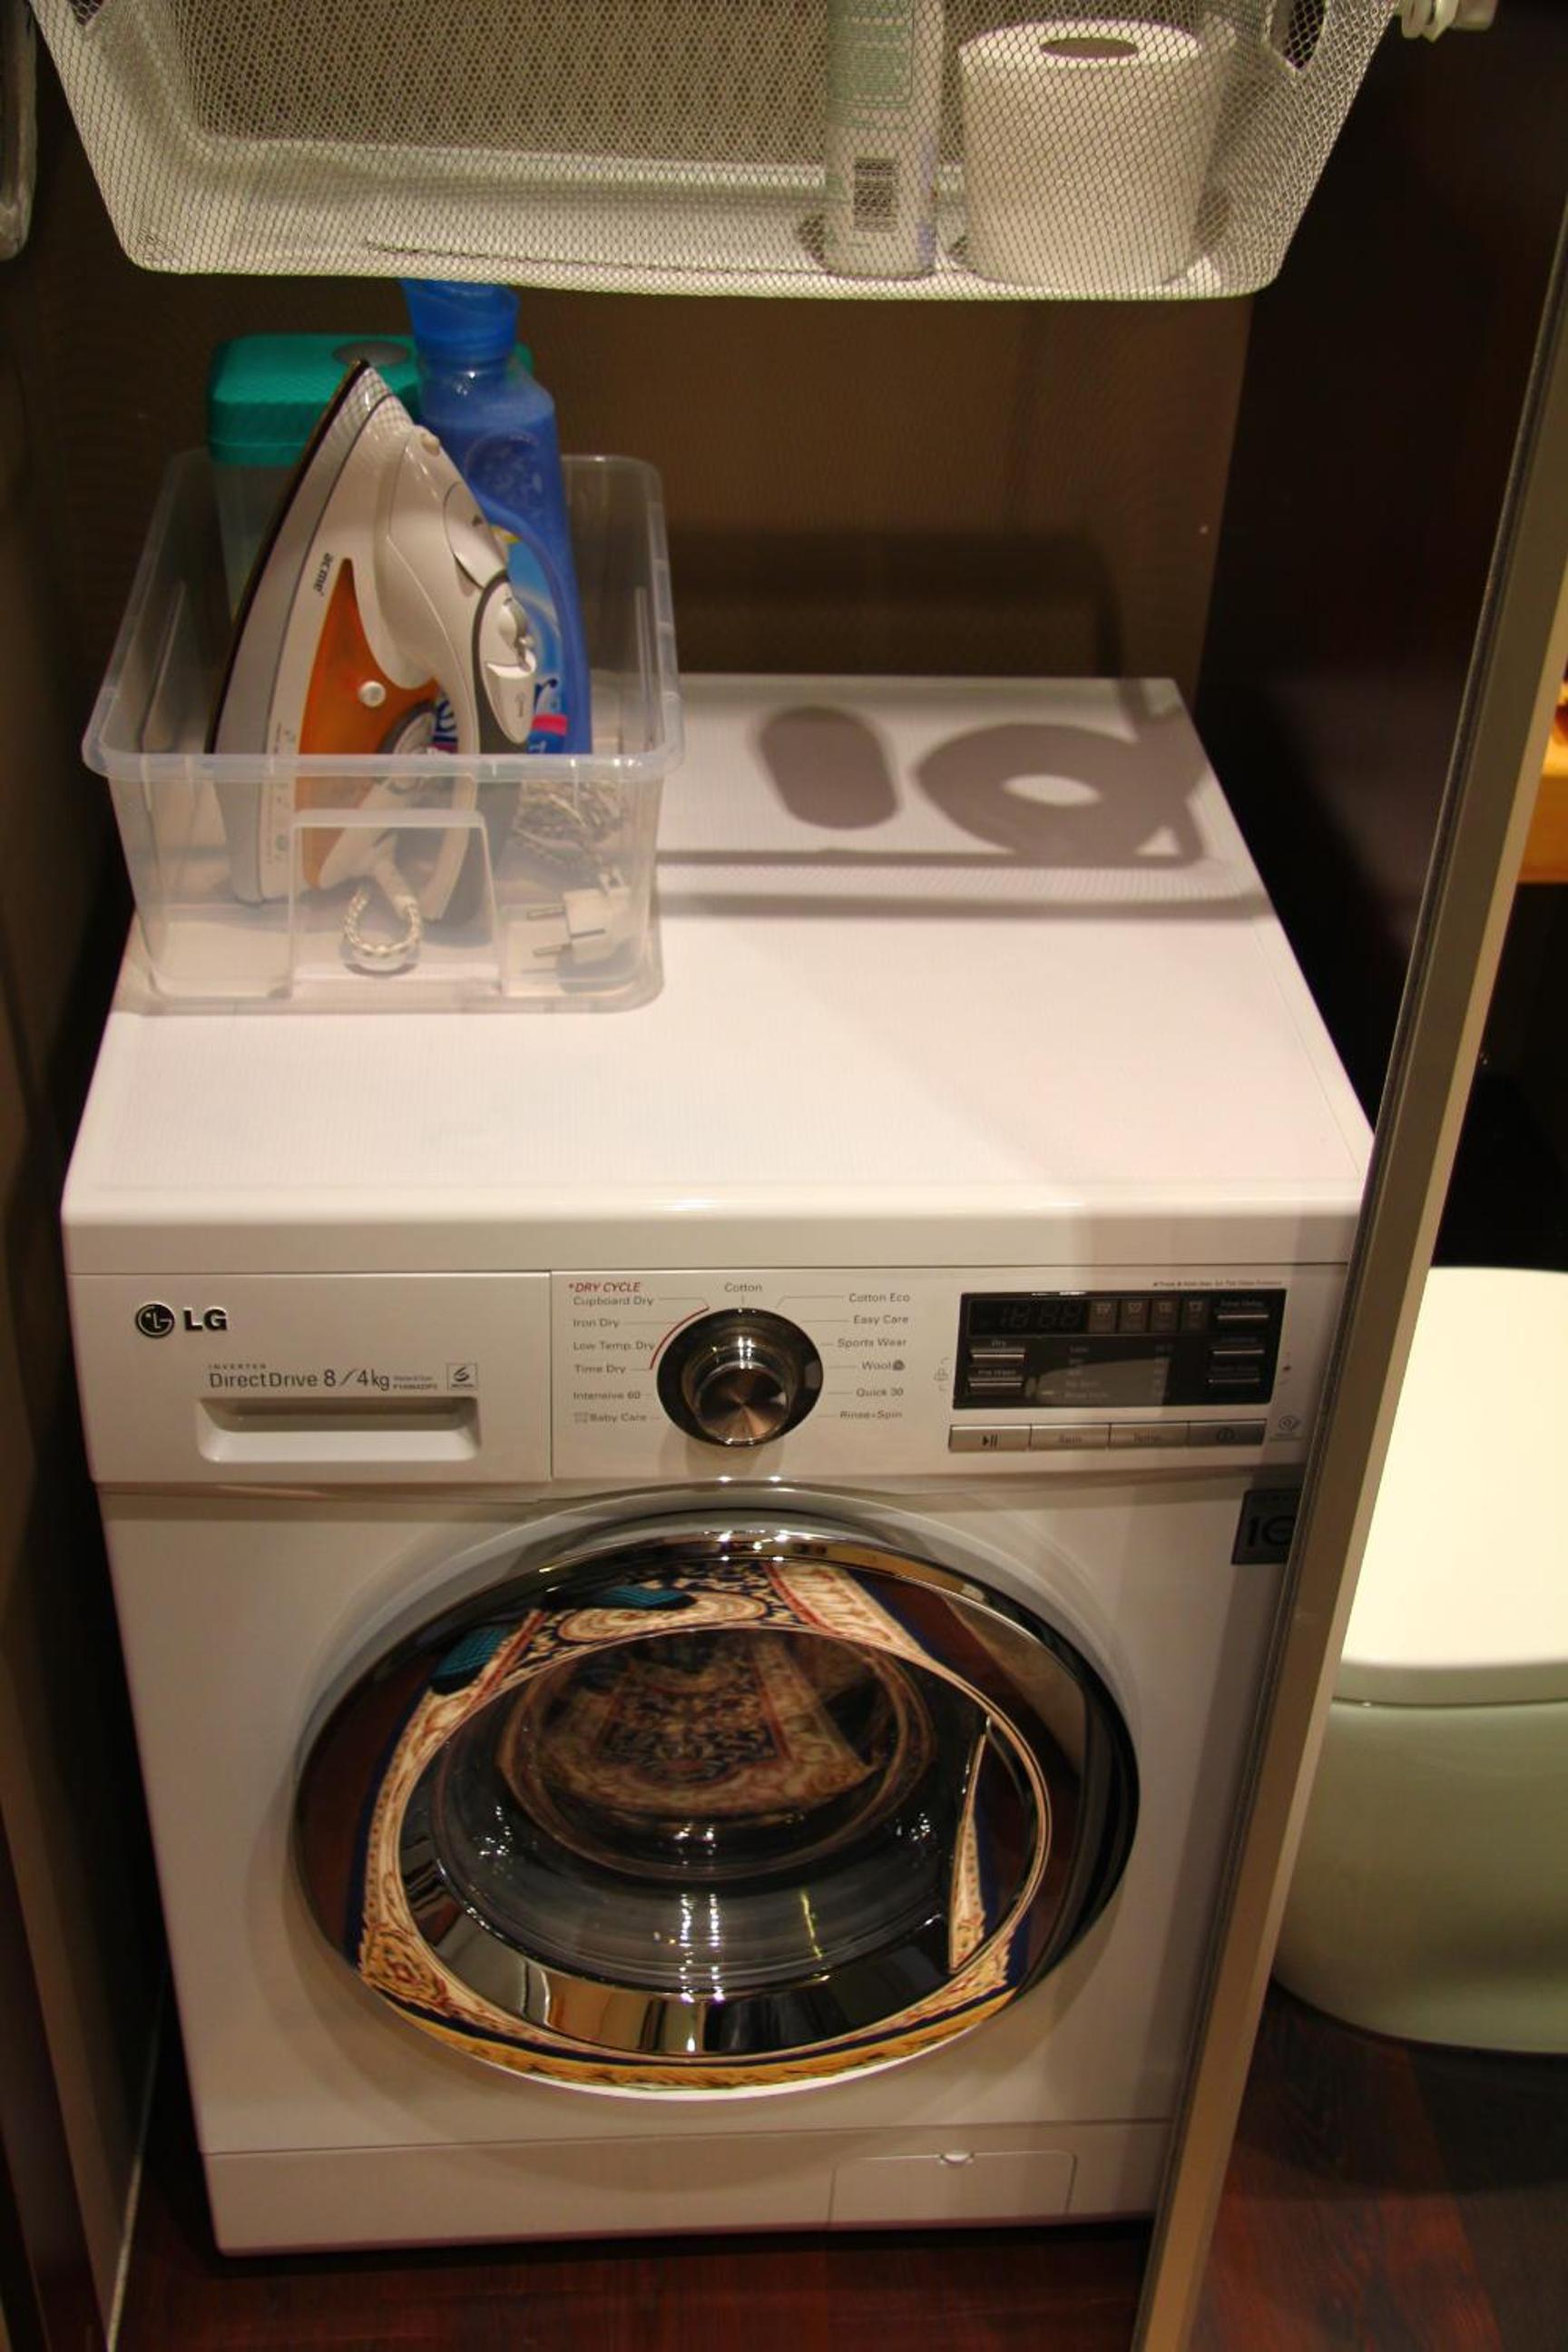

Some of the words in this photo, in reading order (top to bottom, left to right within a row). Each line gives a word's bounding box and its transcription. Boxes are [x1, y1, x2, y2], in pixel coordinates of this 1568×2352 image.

[314, 552, 335, 593] acme
[603, 1281, 641, 1293] CYCLE
[724, 1282, 763, 1293] Cotton
[573, 1296, 631, 1308] Cupboard
[633, 1295, 655, 1307] Dry
[849, 1292, 887, 1303] Cotton
[889, 1292, 911, 1303] Eco
[183, 1307, 228, 1330] LG
[573, 1318, 596, 1328] Iron
[599, 1318, 620, 1329] Dry
[853, 1314, 880, 1327] Easy
[883, 1314, 908, 1325] Care
[573, 1341, 596, 1351] Low
[636, 1342, 656, 1352] Dry
[838, 1338, 874, 1349] Sports
[877, 1338, 907, 1348] Wear
[574, 1365, 603, 1374] Time
[606, 1365, 627, 1376] Dry
[861, 1360, 891, 1371] Wool
[209, 1371, 318, 1389] DirectDrive
[573, 1391, 624, 1400] Intensive
[627, 1391, 642, 1400] 60
[856, 1387, 887, 1398] Quick
[890, 1387, 904, 1397] 30
[589, 1413, 618, 1424] Baby
[621, 1413, 648, 1422] Care
